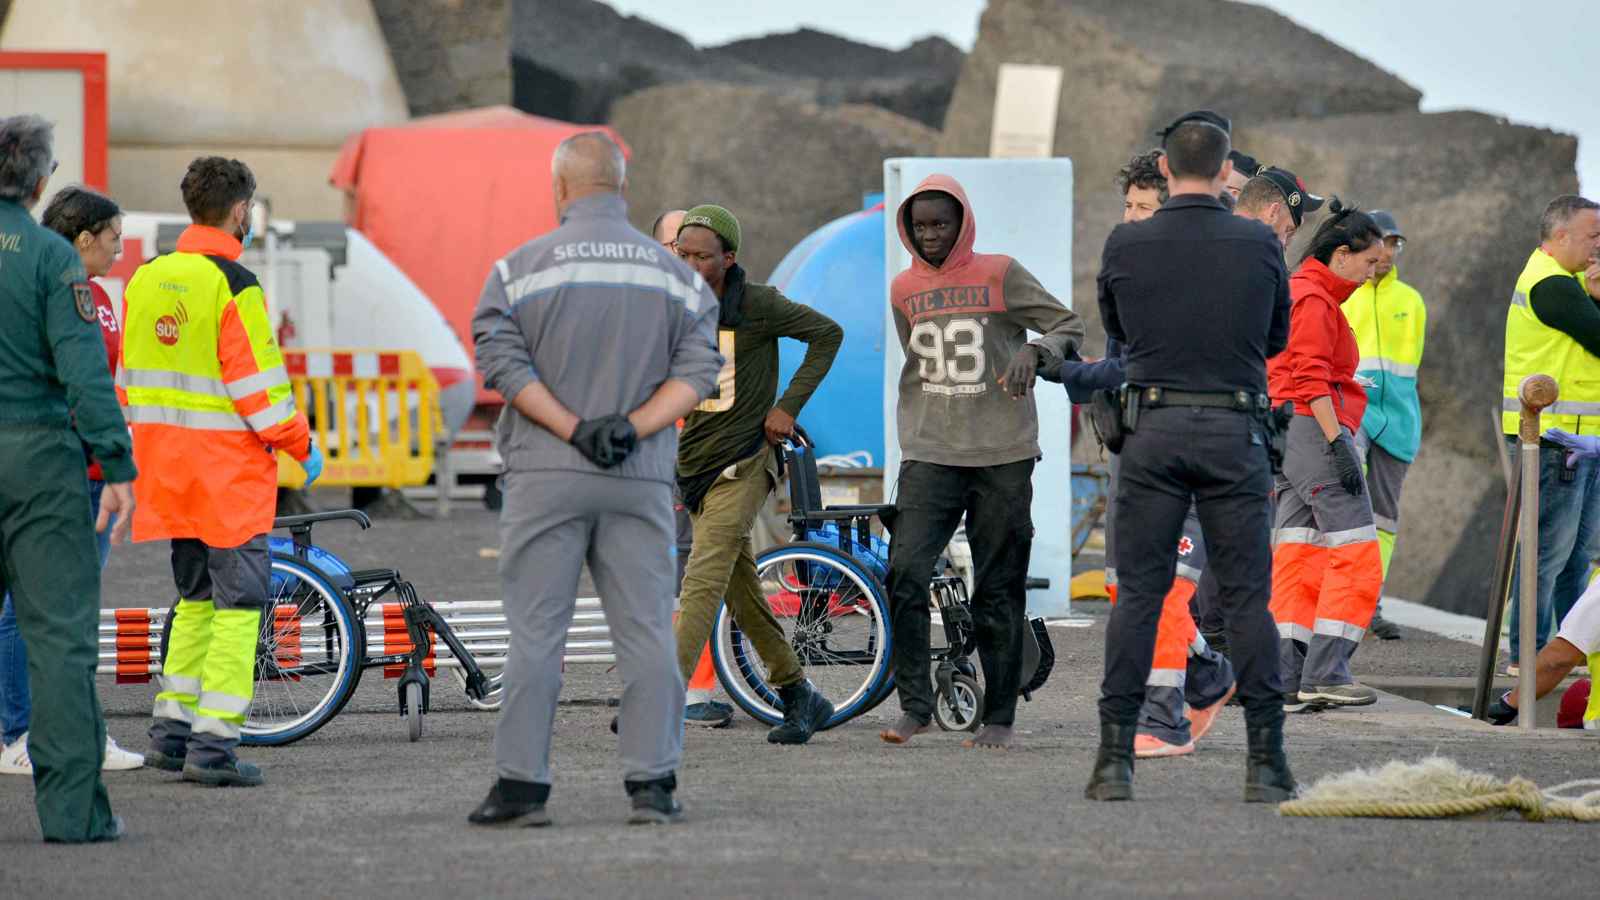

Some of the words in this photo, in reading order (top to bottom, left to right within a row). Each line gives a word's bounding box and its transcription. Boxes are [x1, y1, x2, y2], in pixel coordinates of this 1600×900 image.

[554, 241, 658, 263] SECURITAS
[943, 286, 986, 306] XCIX
[910, 319, 986, 383] 93
